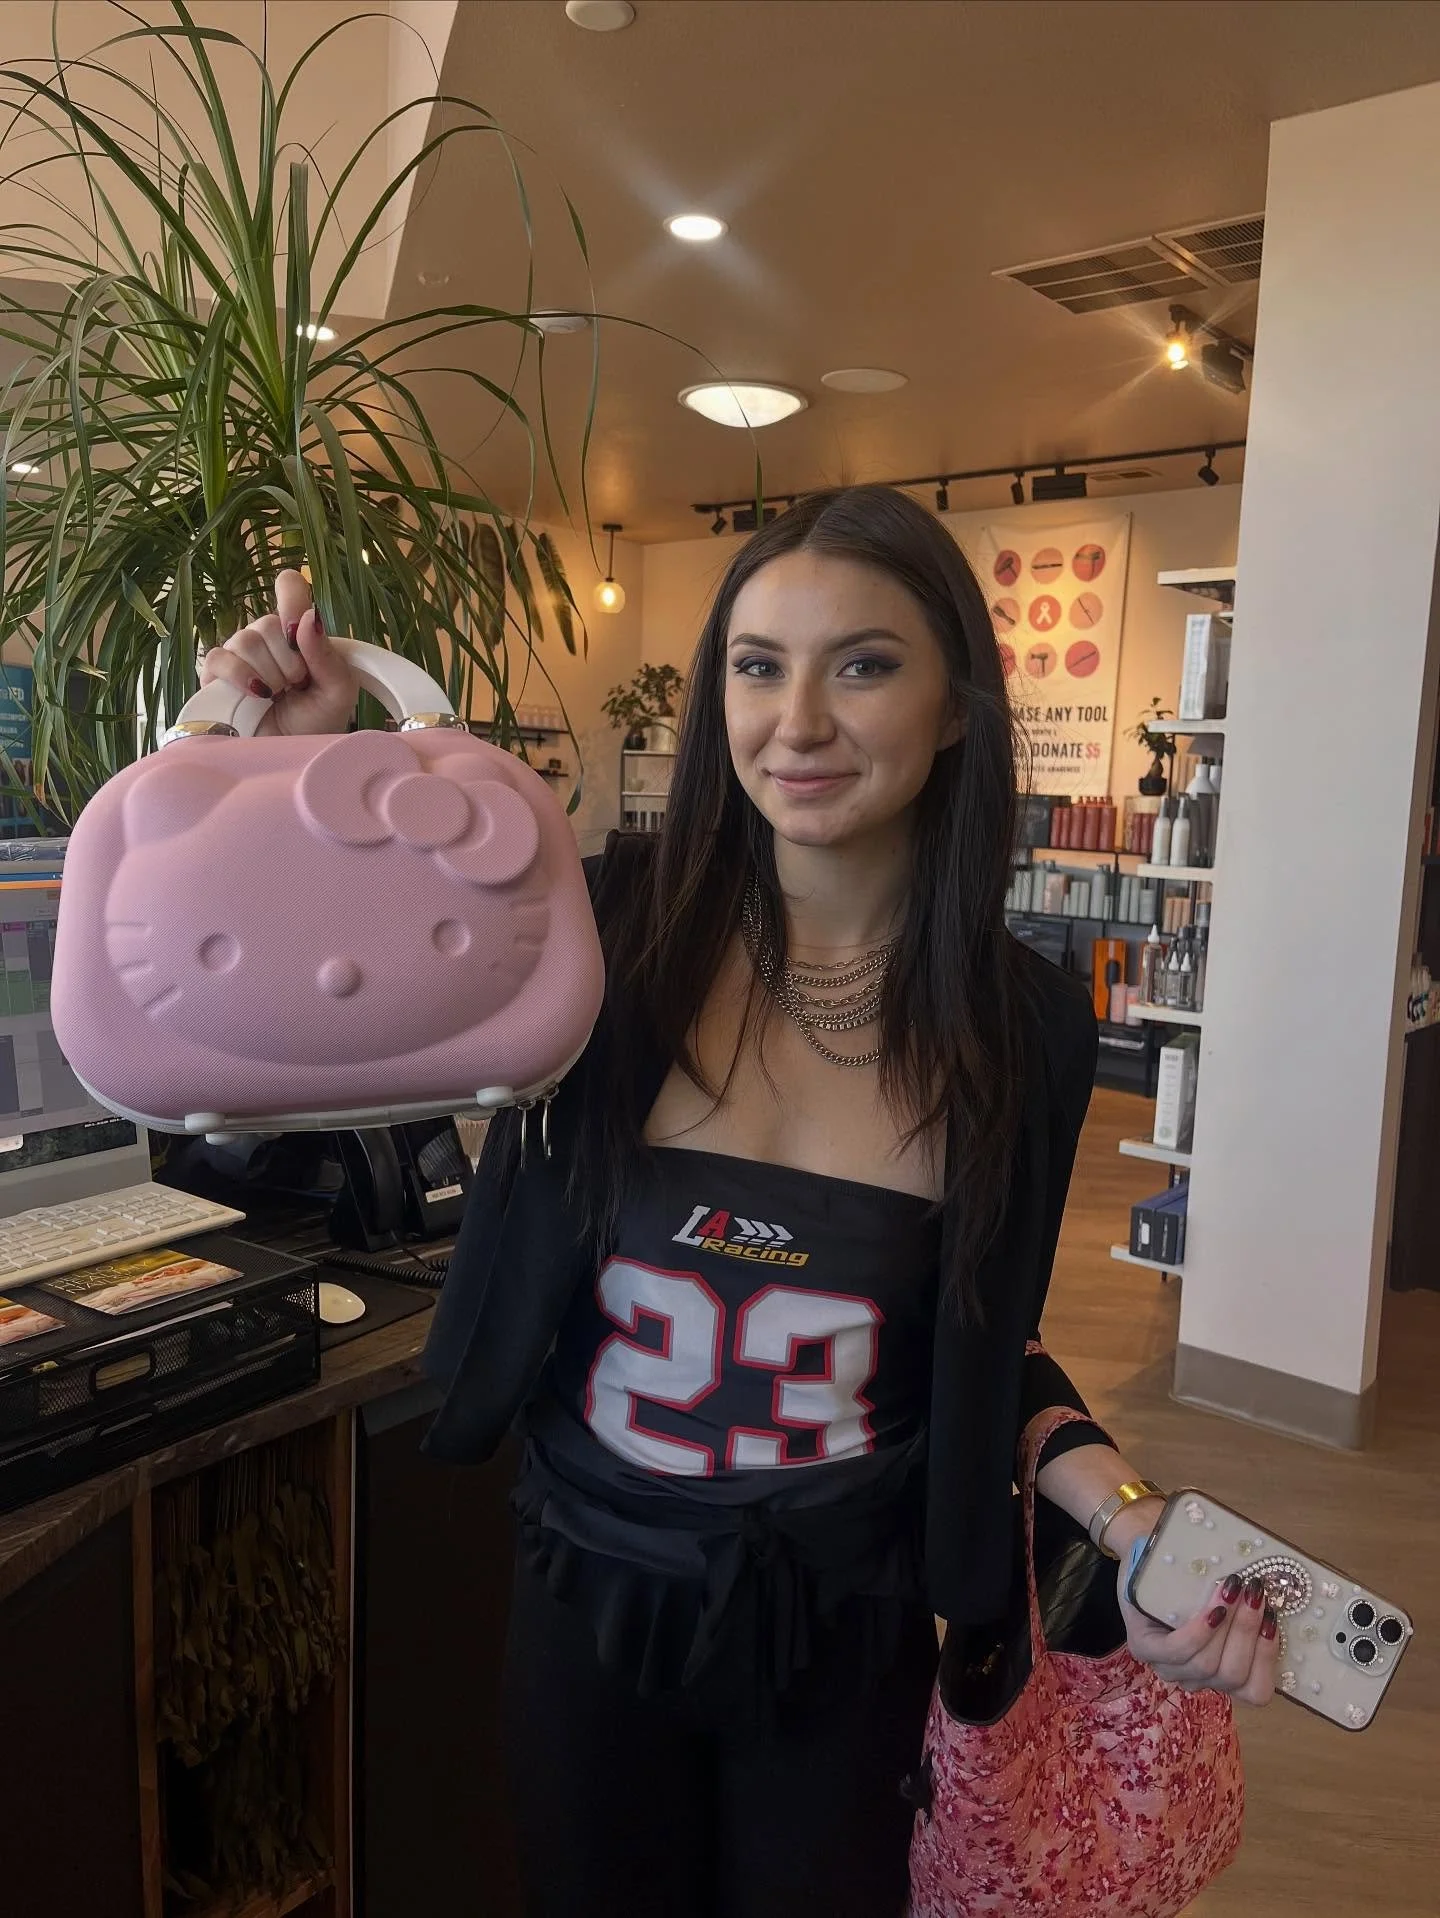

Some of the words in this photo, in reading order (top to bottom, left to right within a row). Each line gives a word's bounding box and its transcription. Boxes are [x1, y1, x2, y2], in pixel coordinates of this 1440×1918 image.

[1045, 706, 1072, 722] ANY
[1077, 705, 1108, 722] TOOL
[1032, 742, 1084, 758] DONATE
[1086, 743, 1101, 758] $5
[671, 1205, 731, 1247] LA
[701, 1237, 810, 1268] Racing
[584, 1255, 886, 1478] 23
